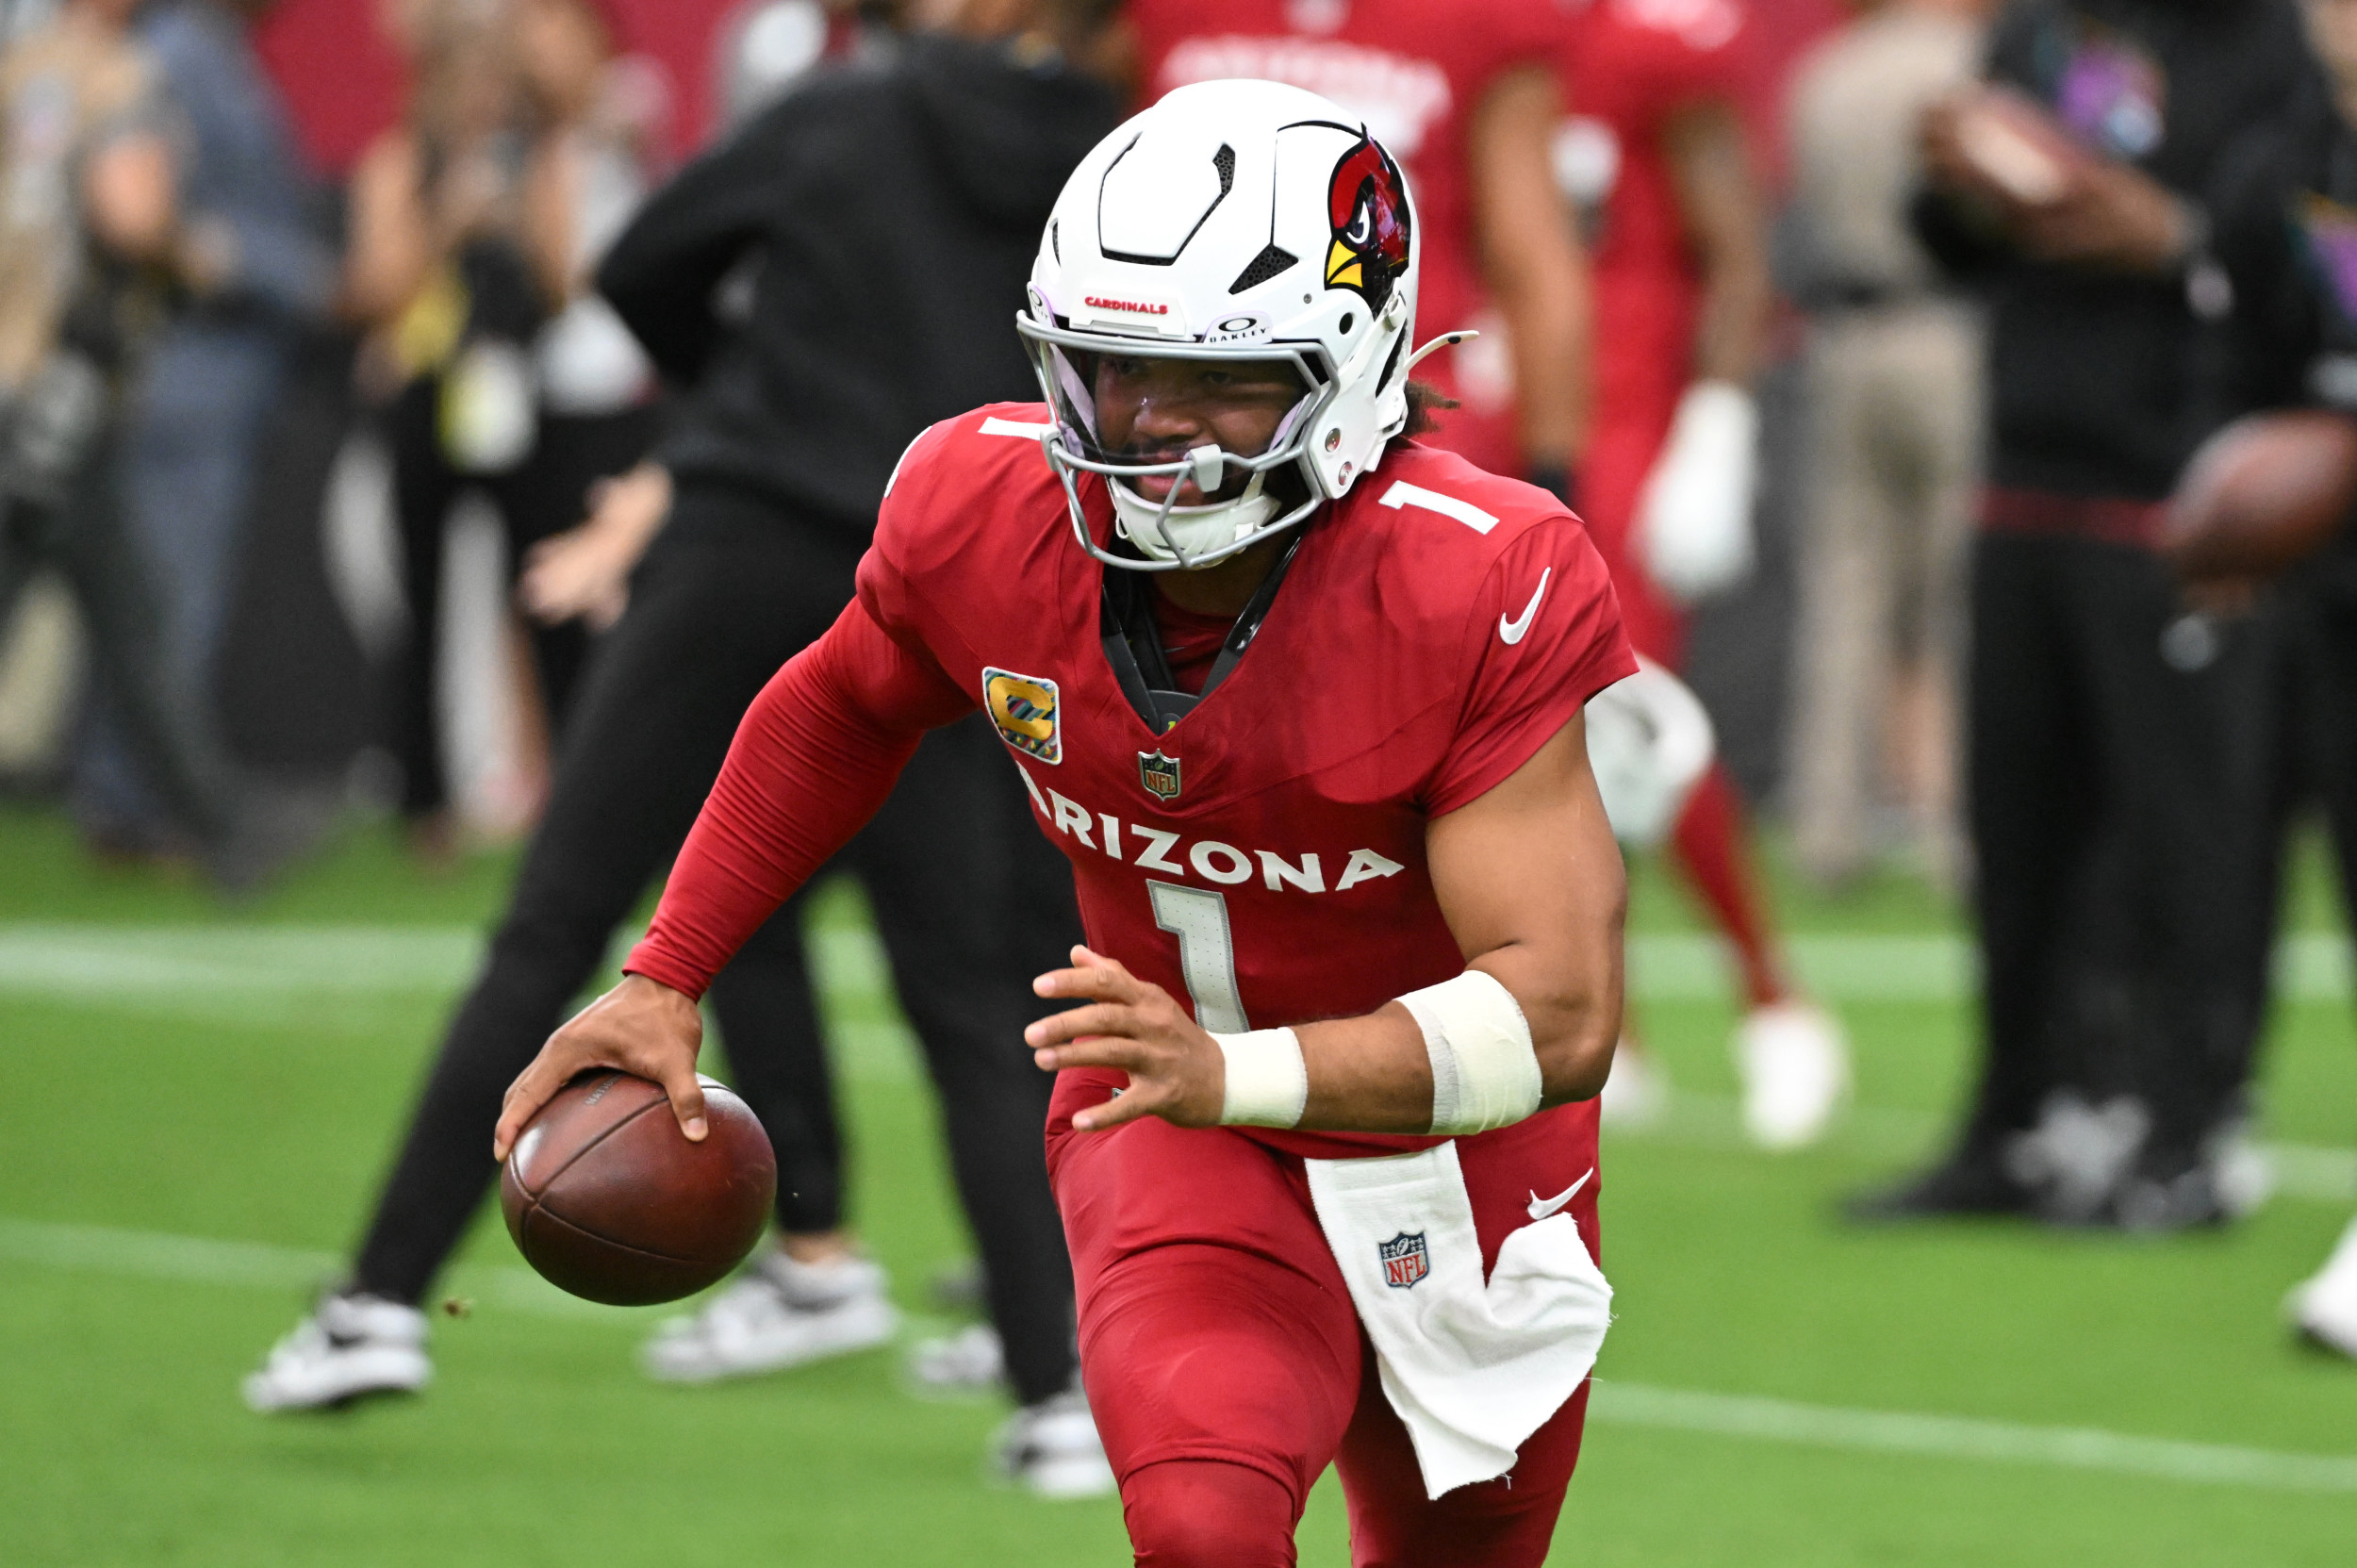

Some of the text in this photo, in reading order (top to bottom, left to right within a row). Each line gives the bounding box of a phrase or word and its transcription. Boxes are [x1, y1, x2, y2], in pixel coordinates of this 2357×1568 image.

[1084, 295, 1169, 316] CARDINALS
[1209, 327, 1267, 344] OAKLEY
[1377, 479, 1501, 536] 1
[988, 676, 1053, 741] C
[1146, 770, 1177, 792] NFL
[1146, 878, 1252, 1035] 1
[1386, 1253, 1426, 1283] NFL
